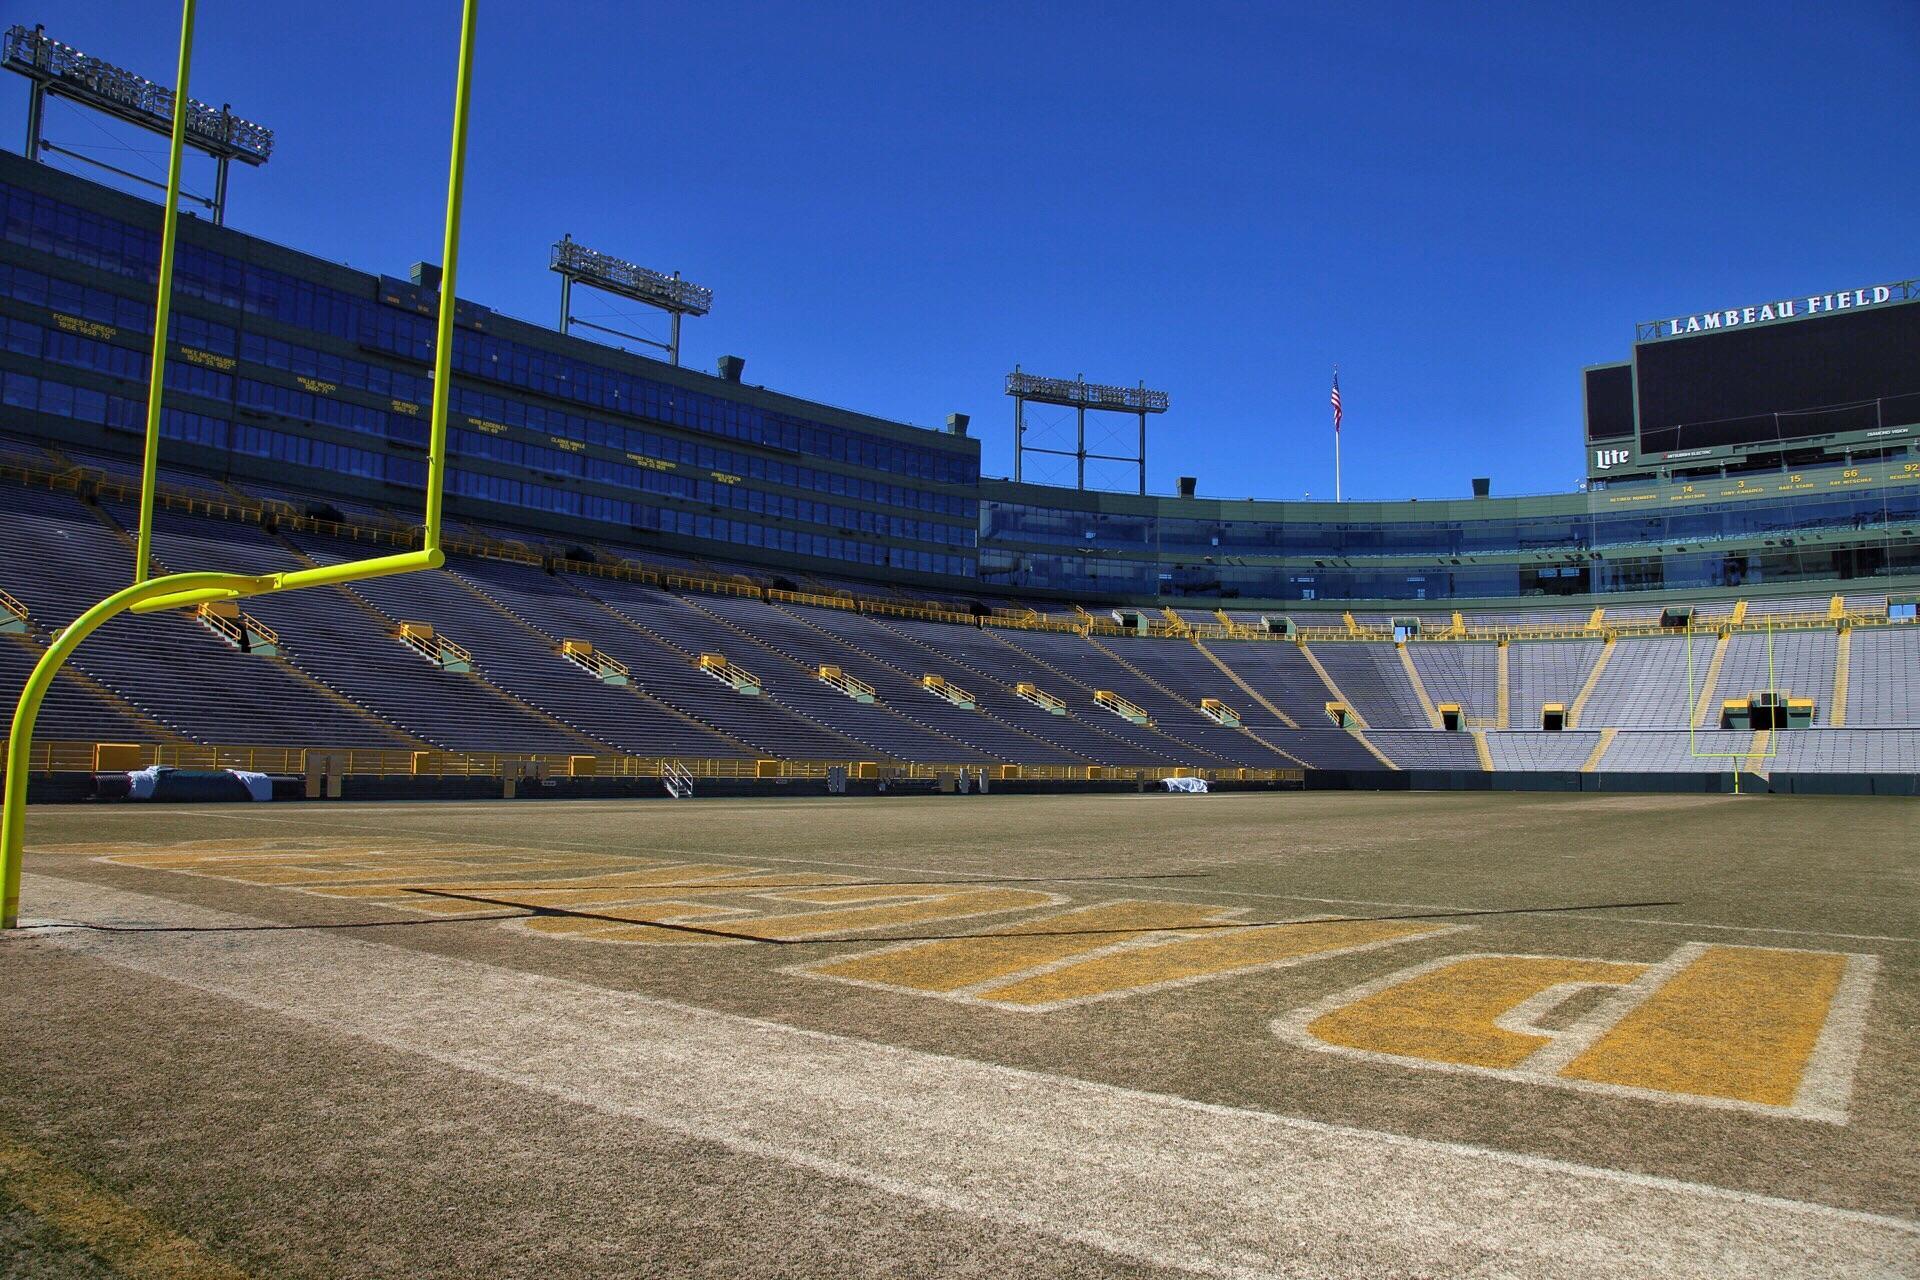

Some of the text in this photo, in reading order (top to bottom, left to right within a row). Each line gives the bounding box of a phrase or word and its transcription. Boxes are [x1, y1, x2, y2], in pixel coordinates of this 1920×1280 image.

[1670, 286, 1890, 335] LAMBEAU FIELD
[53, 313, 117, 335] FORREST GREGG
[181, 347, 199, 357] MIKE
[296, 376, 337, 391] WILLIE WOOD
[1596, 449, 1629, 470] Lite
[1904, 463, 1919, 472] 92
[1843, 469, 1858, 478] 66
[1790, 474, 1801, 483] 15
[1737, 480, 1745, 488] 3
[1682, 485, 1694, 493] 14
